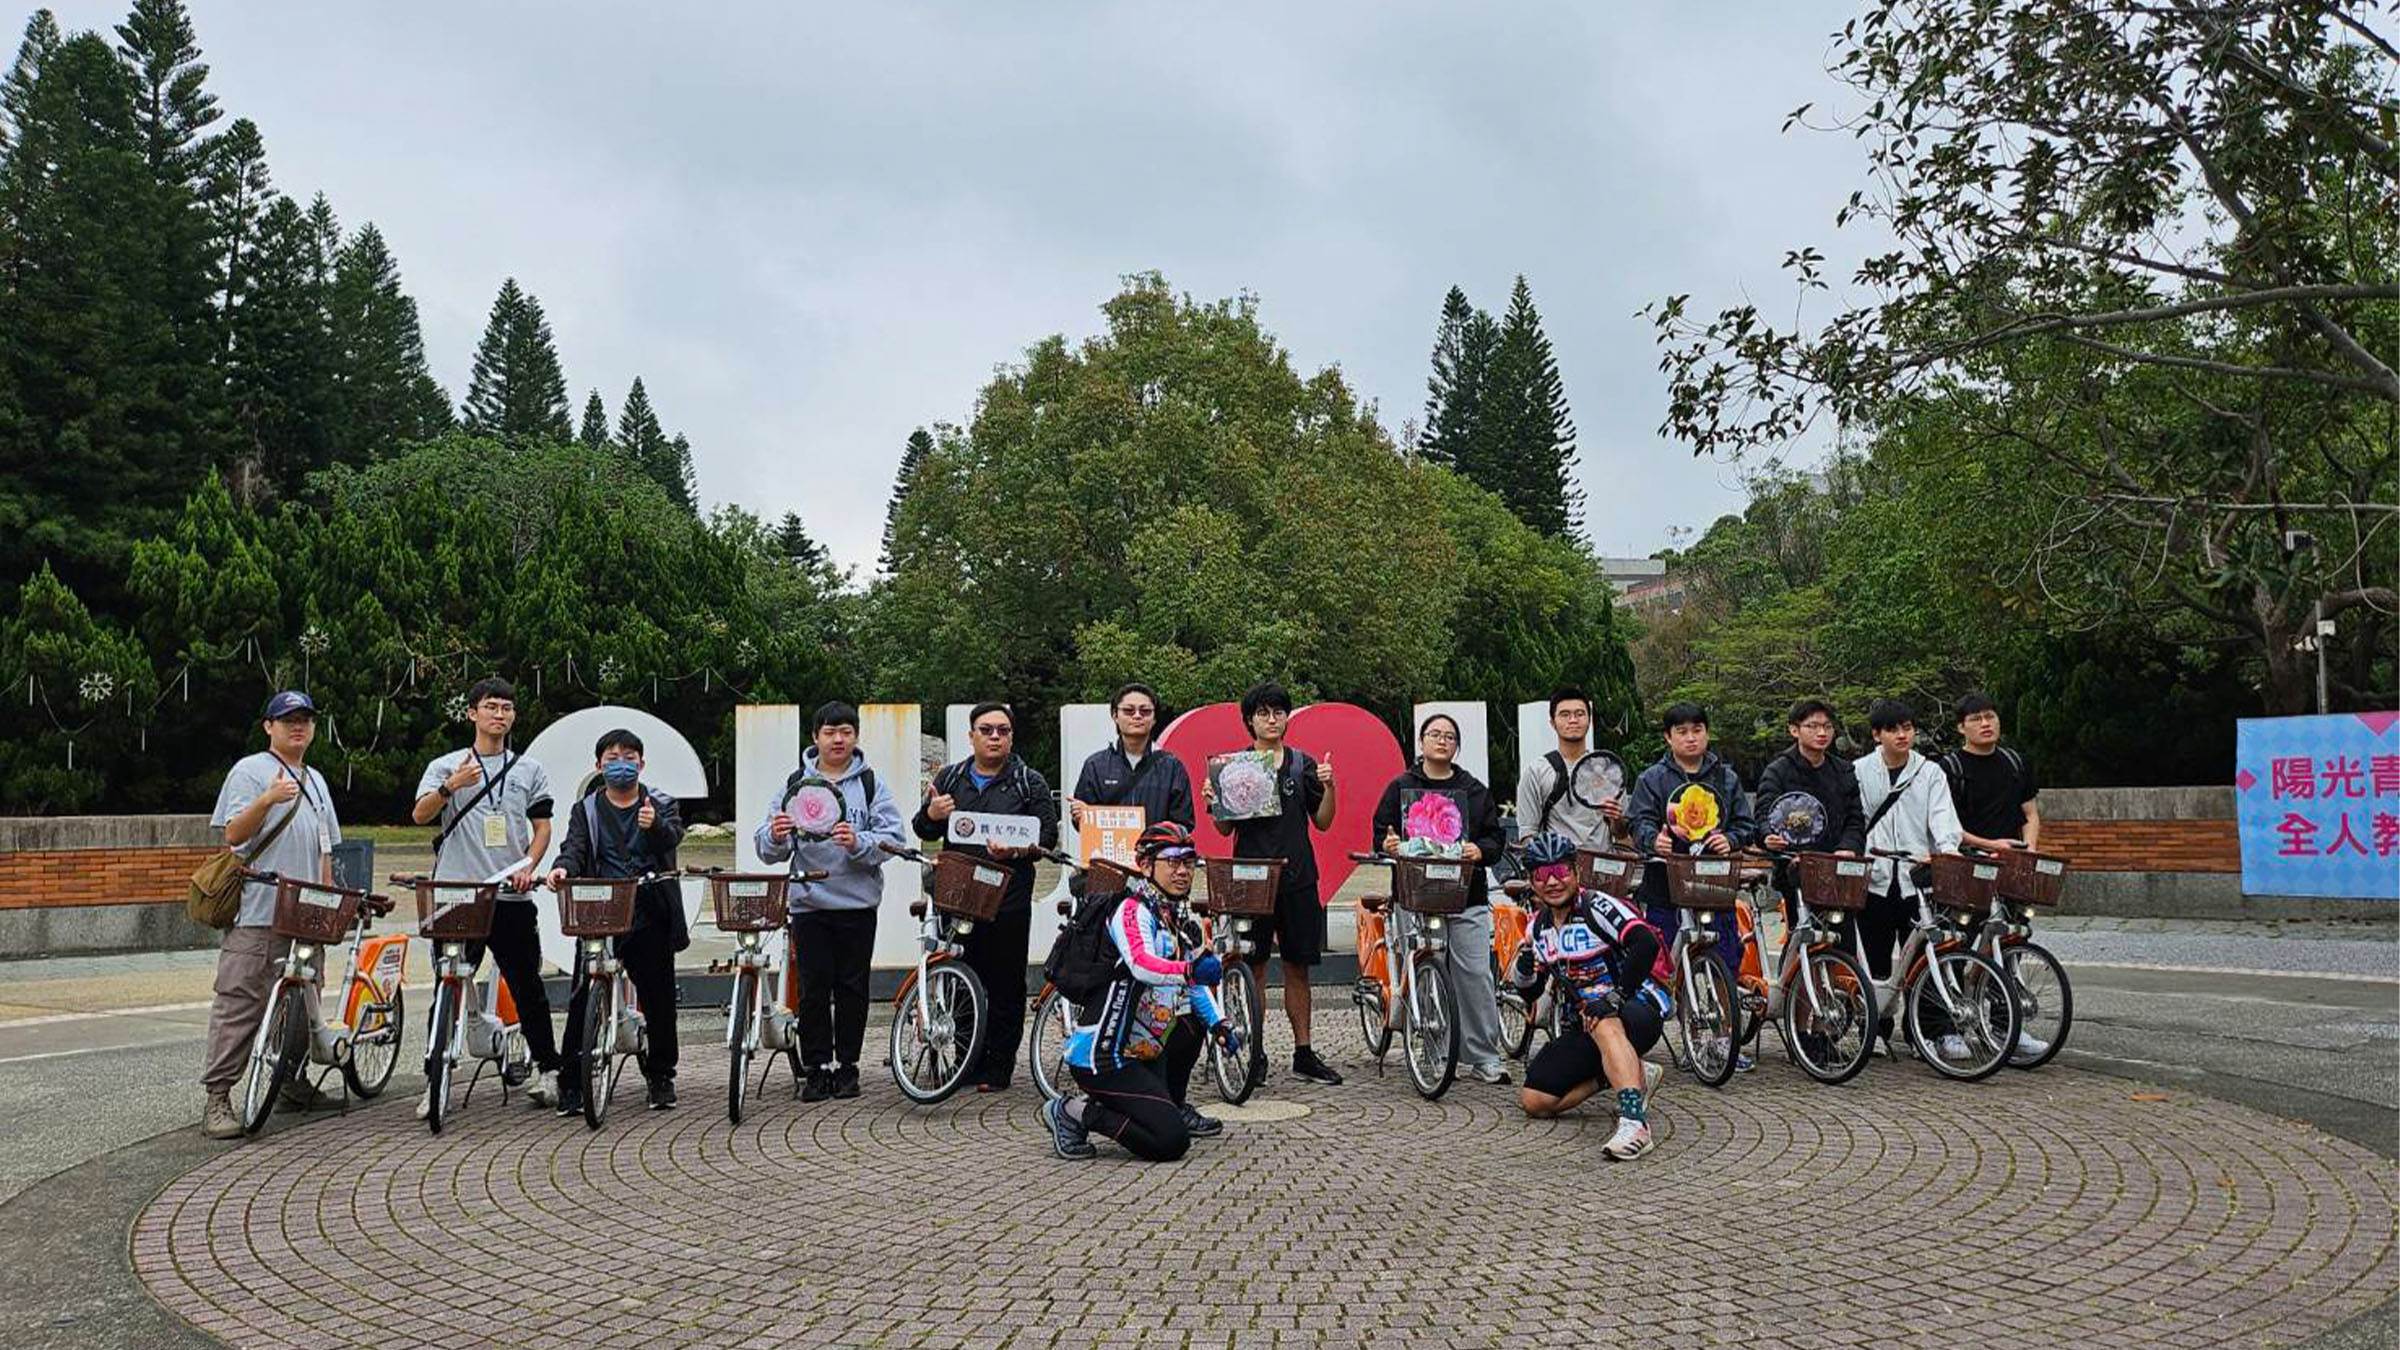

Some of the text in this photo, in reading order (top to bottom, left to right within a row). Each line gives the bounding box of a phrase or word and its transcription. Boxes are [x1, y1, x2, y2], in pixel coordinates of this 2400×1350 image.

[2271, 754, 2399, 799] 陽光青
[2276, 812, 2399, 857] 全人教
